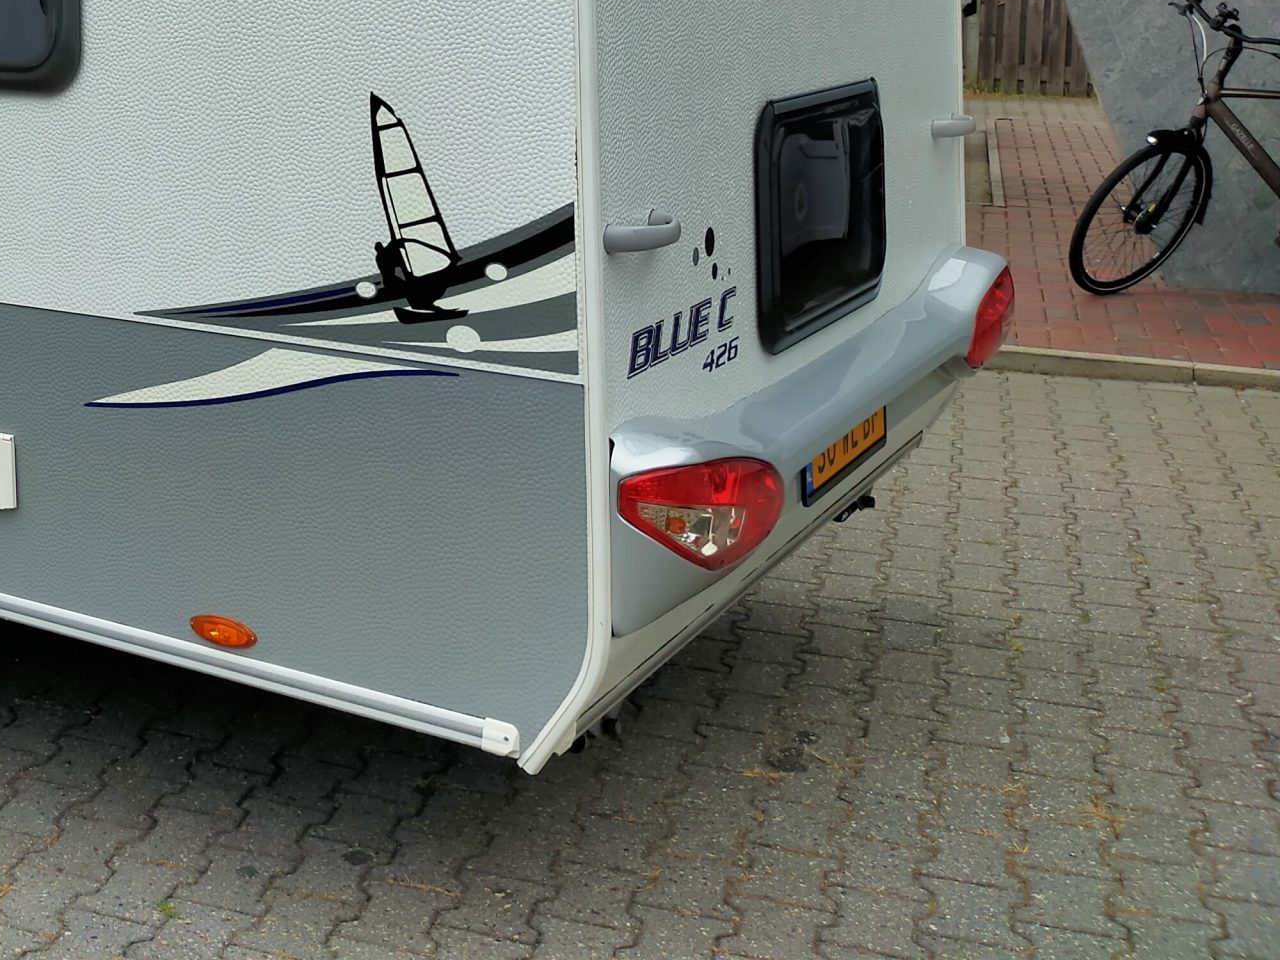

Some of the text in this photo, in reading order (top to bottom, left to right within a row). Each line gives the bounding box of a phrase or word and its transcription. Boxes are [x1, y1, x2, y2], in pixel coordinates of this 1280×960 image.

[627, 285, 737, 380] BLUE C
[702, 336, 740, 373] 426
